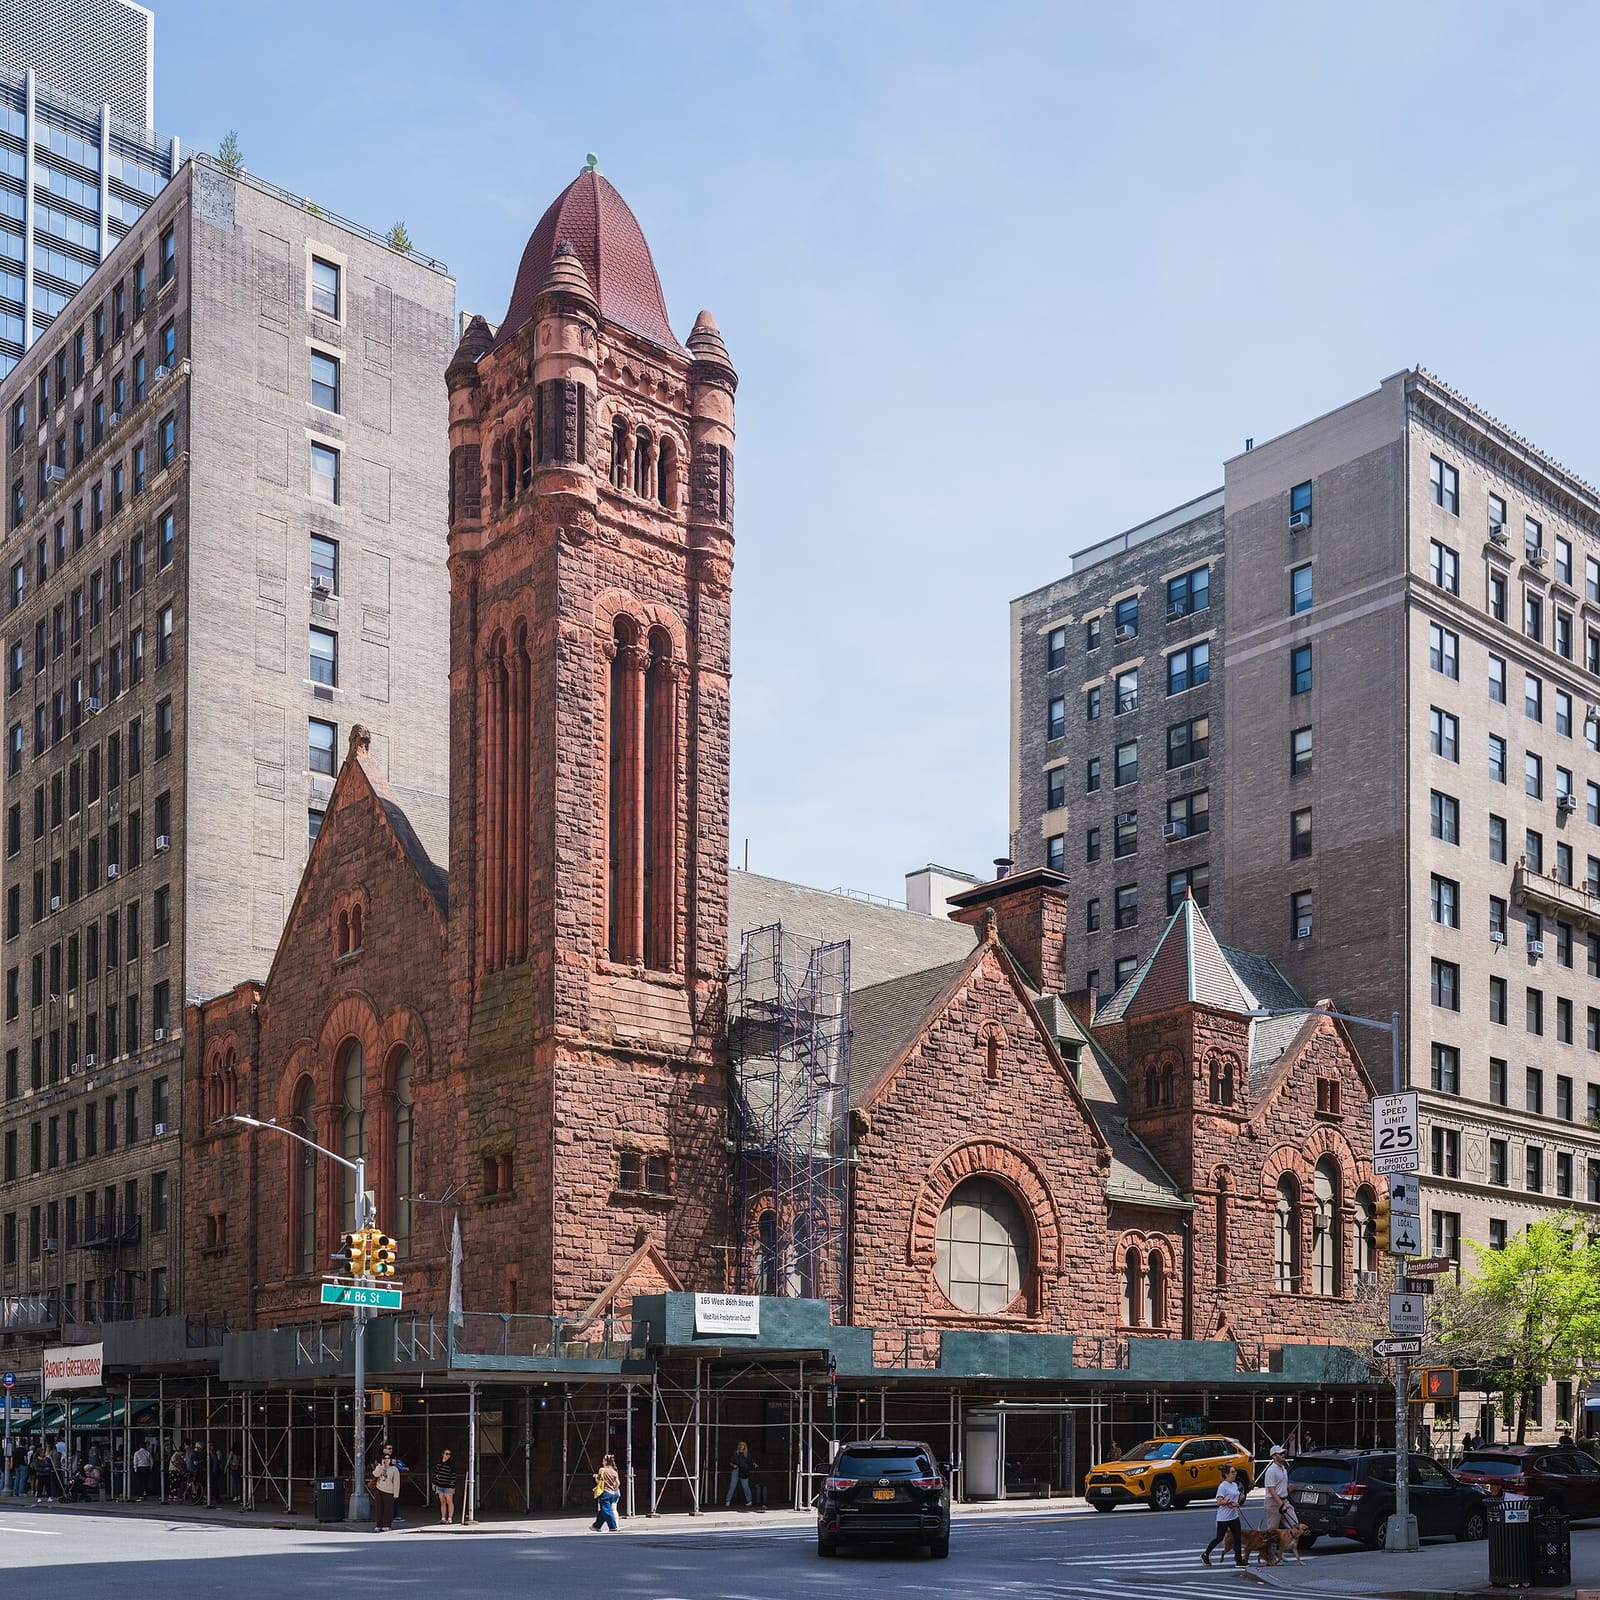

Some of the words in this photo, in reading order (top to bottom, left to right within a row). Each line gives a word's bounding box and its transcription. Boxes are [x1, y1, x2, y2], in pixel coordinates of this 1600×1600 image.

[1385, 1097, 1403, 1106] CITY
[1381, 1106, 1408, 1116] SPEED
[1384, 1116, 1405, 1125] LIMIT
[1380, 1125, 1412, 1150] 25
[1384, 1156, 1408, 1165] PHOTO
[1377, 1162, 1415, 1172] ENFORCED
[1406, 1184, 1418, 1193] TRUCK
[1406, 1196, 1418, 1206] ROUTE
[1397, 1219, 1413, 1228] LOCAL
[1407, 1261, 1439, 1271] Amsterdam
[344, 1289, 352, 1301] W
[354, 1291, 367, 1302] 86
[370, 1292, 380, 1304] St
[701, 1296, 711, 1305] 165
[711, 1297, 725, 1306] West
[725, 1297, 738, 1306] 86th
[738, 1298, 754, 1307] Street
[1378, 1343, 1394, 1352] ONE
[1401, 1342, 1417, 1351] WAY
[45, 1360, 65, 1379] BARNEY
[65, 1357, 101, 1377] GREENGRASS
